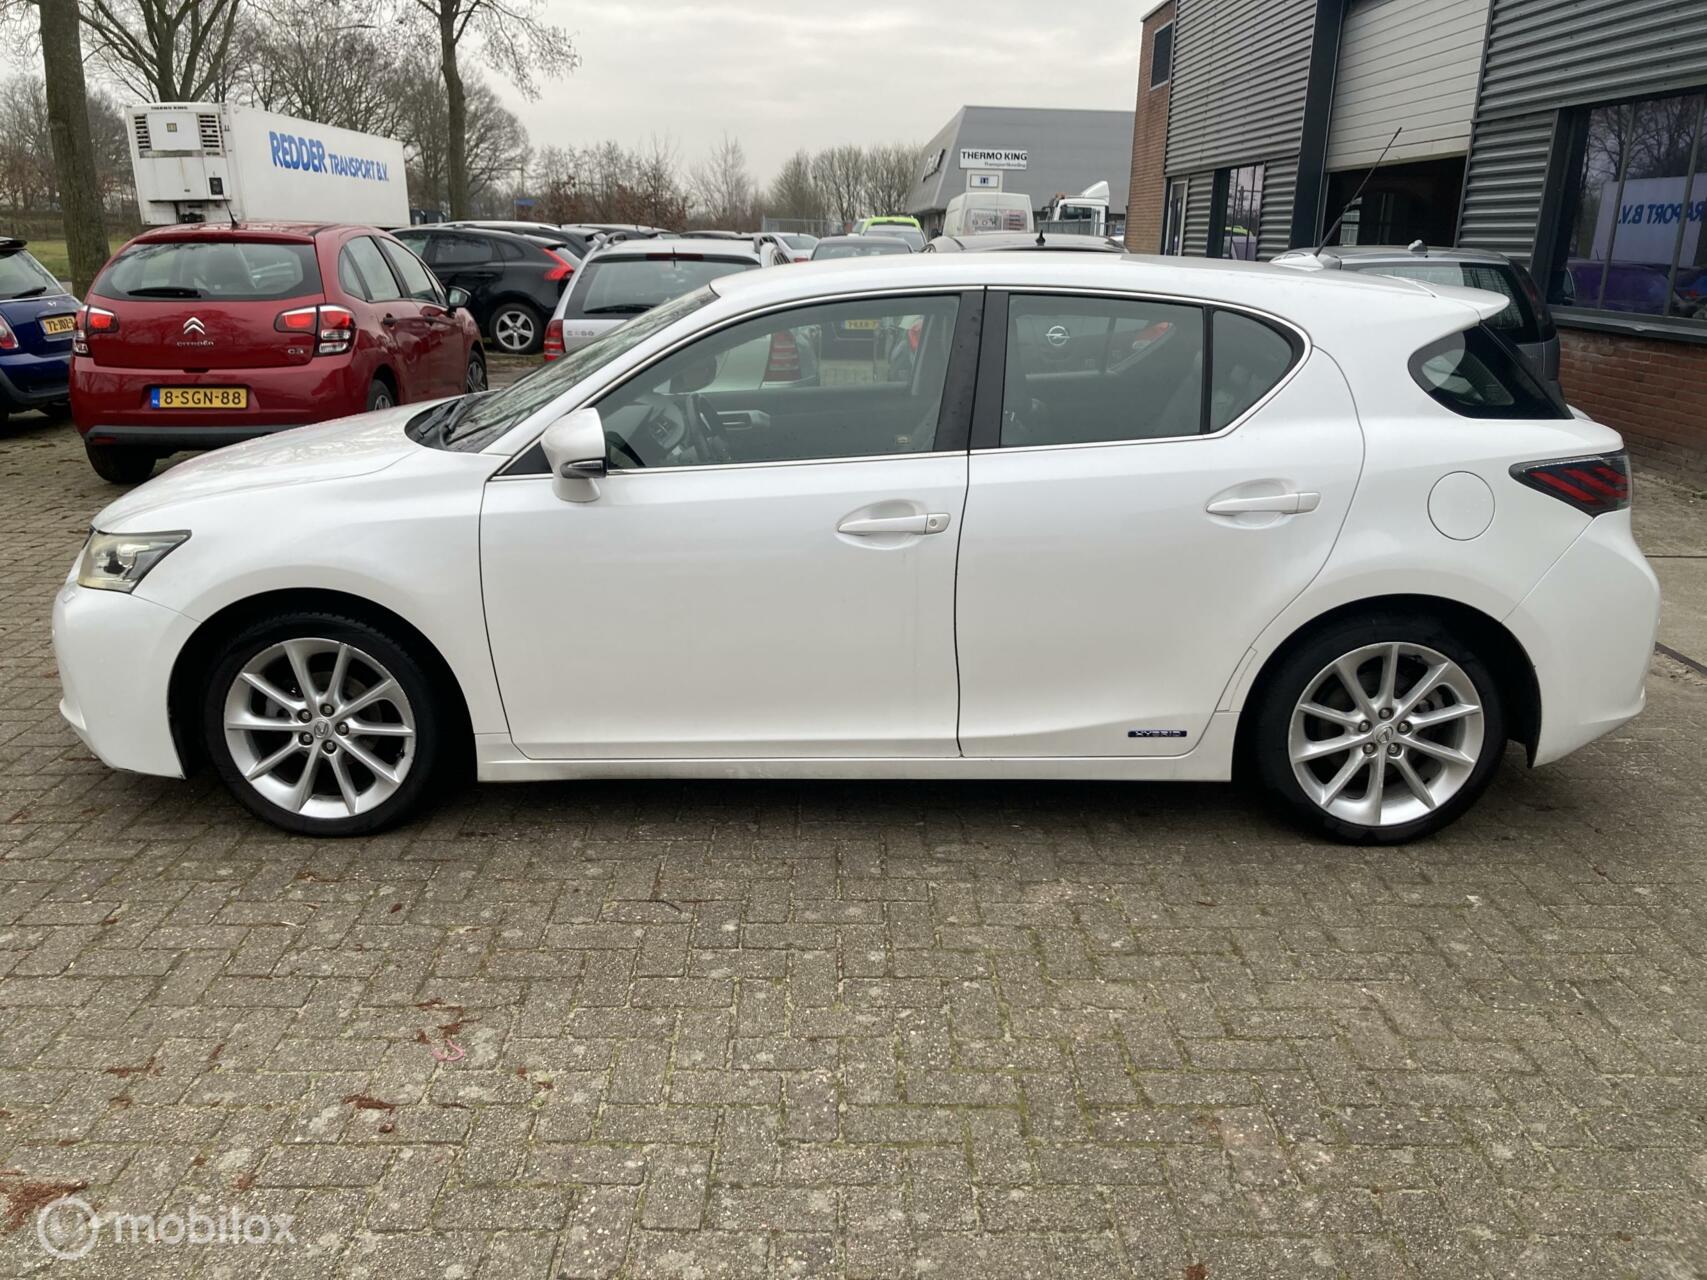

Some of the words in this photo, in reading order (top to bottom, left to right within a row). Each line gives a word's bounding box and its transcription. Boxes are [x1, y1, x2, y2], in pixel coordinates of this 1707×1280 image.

[269, 131, 328, 174] REDDER
[328, 153, 376, 179] TRANSPORT
[376, 161, 390, 181] B.V.
[962, 151, 1002, 161] THERMO
[1004, 152, 1027, 161] KING
[164, 391, 242, 405] 8-SGN-88
